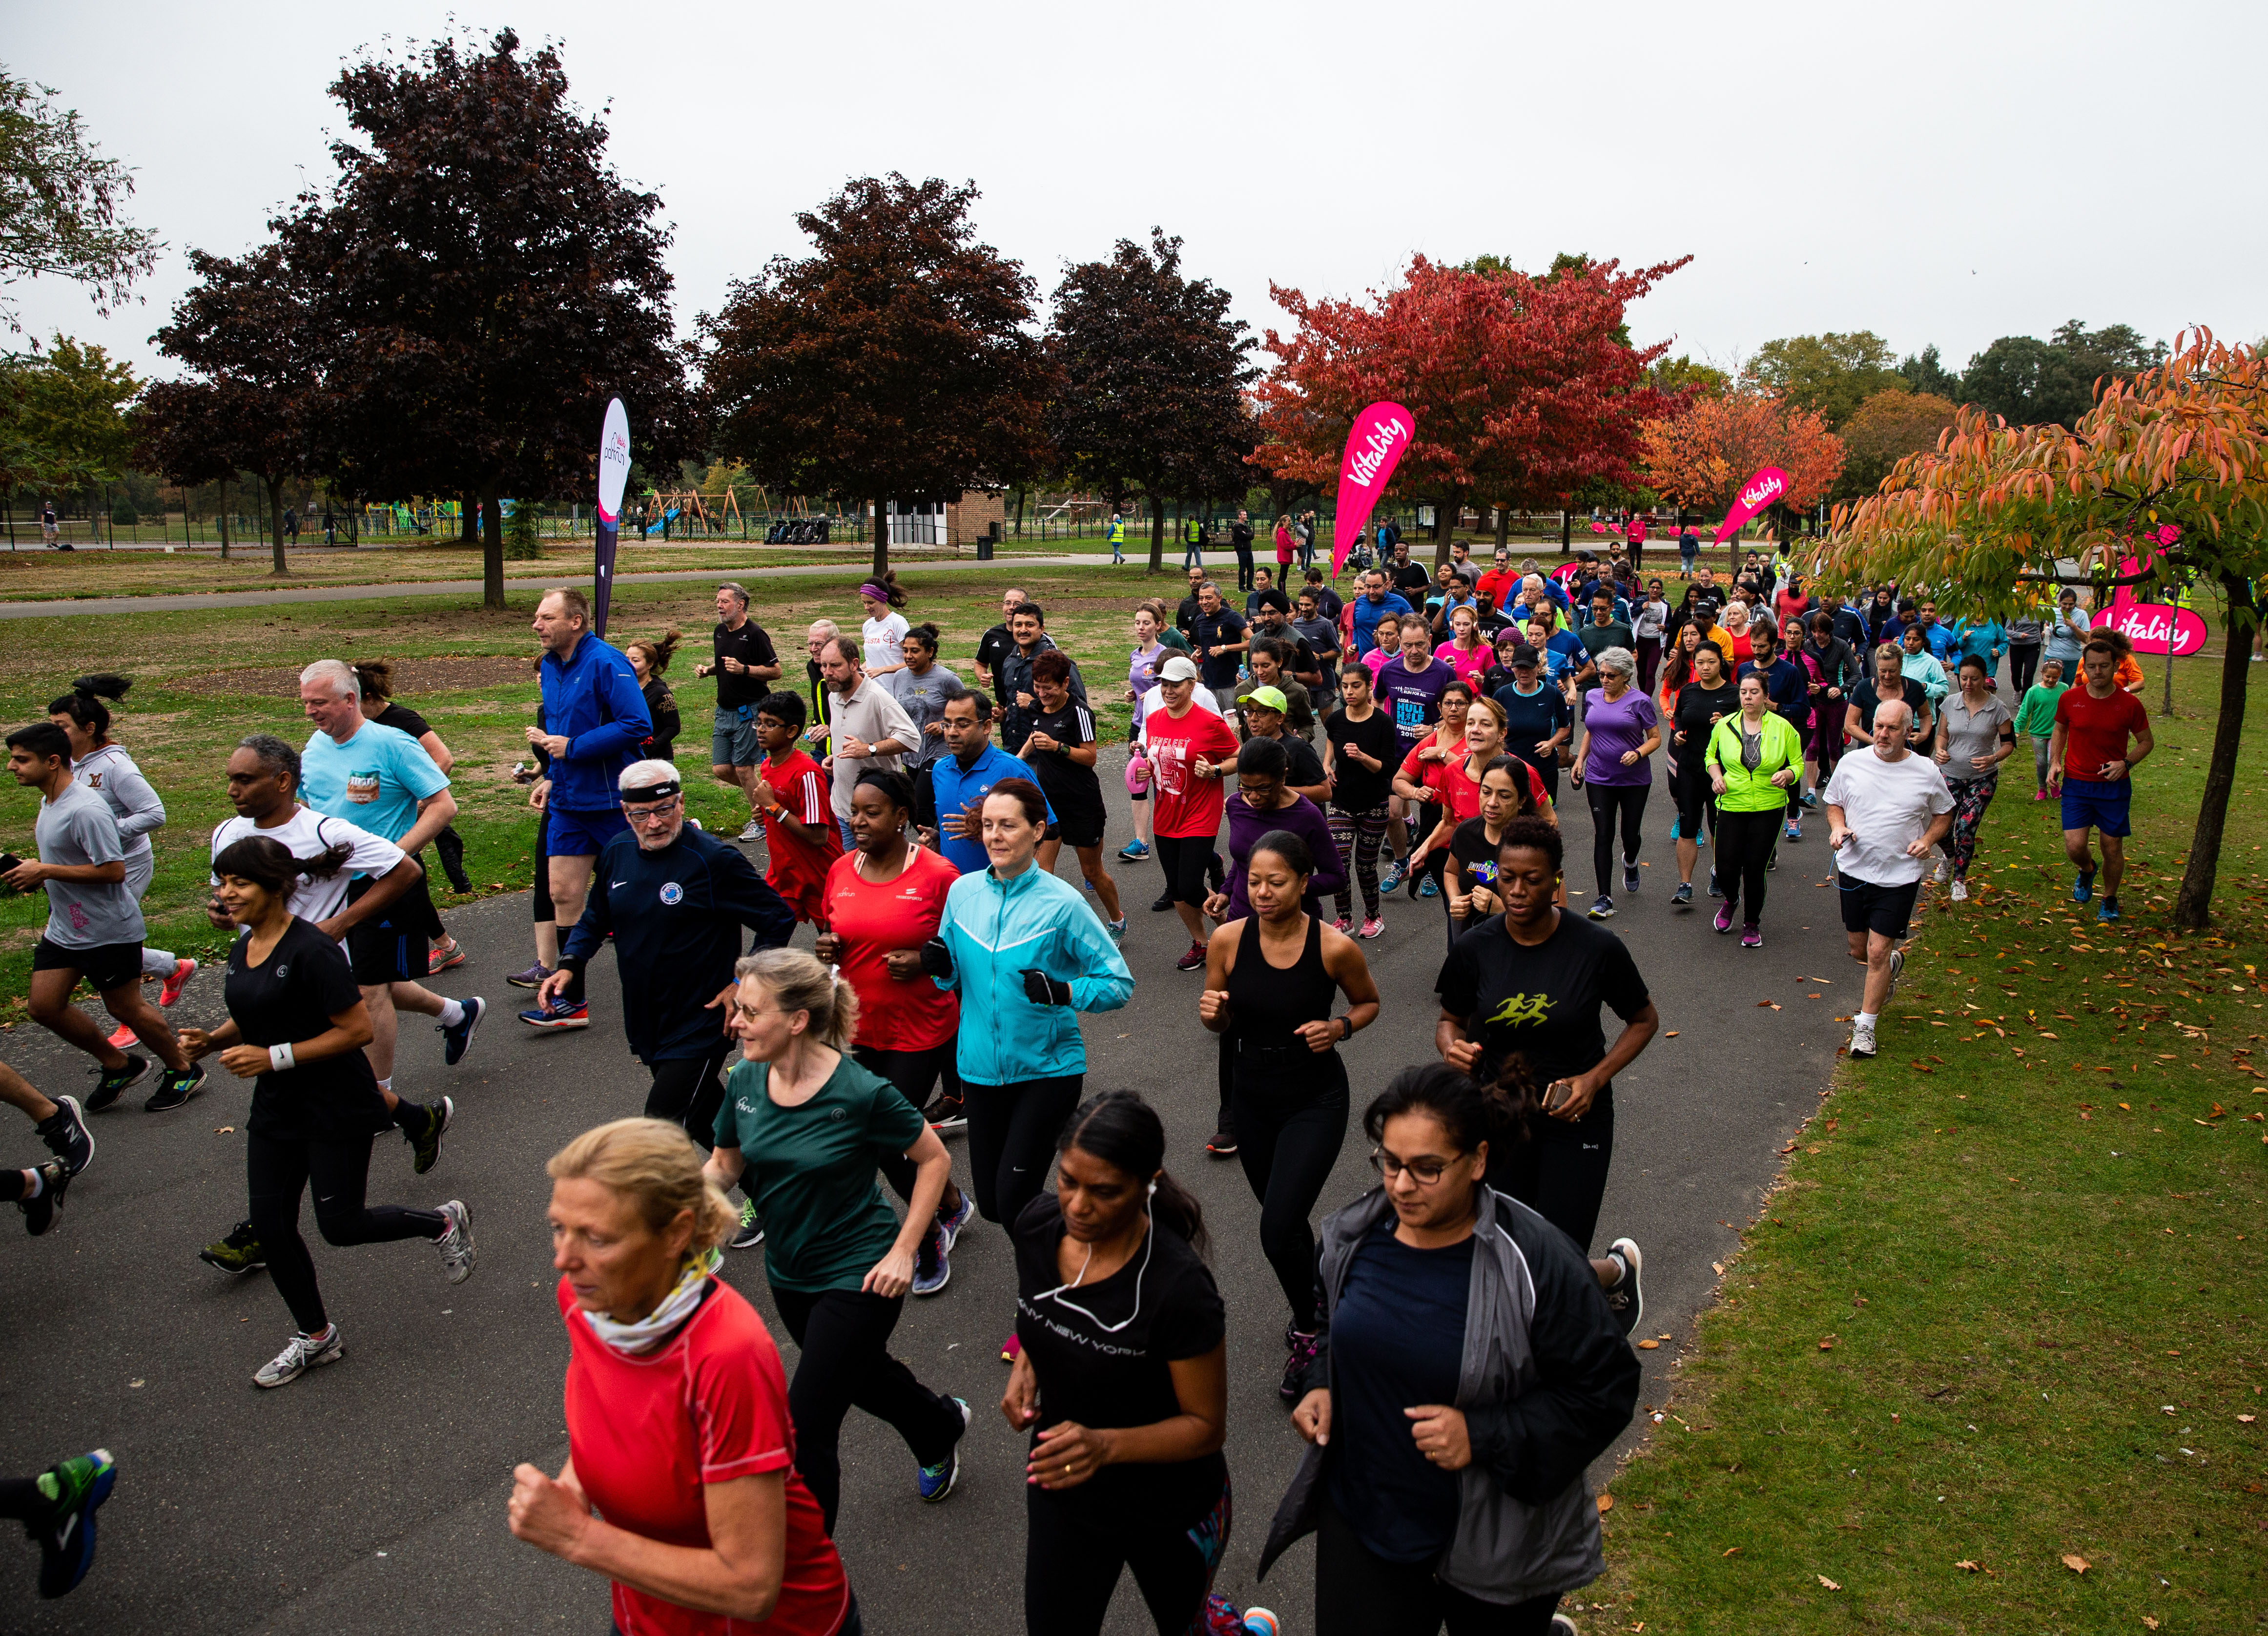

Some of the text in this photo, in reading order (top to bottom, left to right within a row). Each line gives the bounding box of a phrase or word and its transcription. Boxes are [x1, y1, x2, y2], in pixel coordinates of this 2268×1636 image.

[604, 438, 625, 466] parkrun
[1347, 418, 1407, 487] Vitality
[1741, 476, 1782, 509] Vitality
[1479, 630, 1493, 638] AK
[1397, 702, 1424, 715] HULL
[1149, 736, 1191, 748] BENFLEET
[1468, 861, 1491, 873] UNIVERSAL
[837, 888, 855, 898] parkrun
[1045, 1319, 1089, 1345] NEW
[1091, 1340, 1146, 1357] YORK
